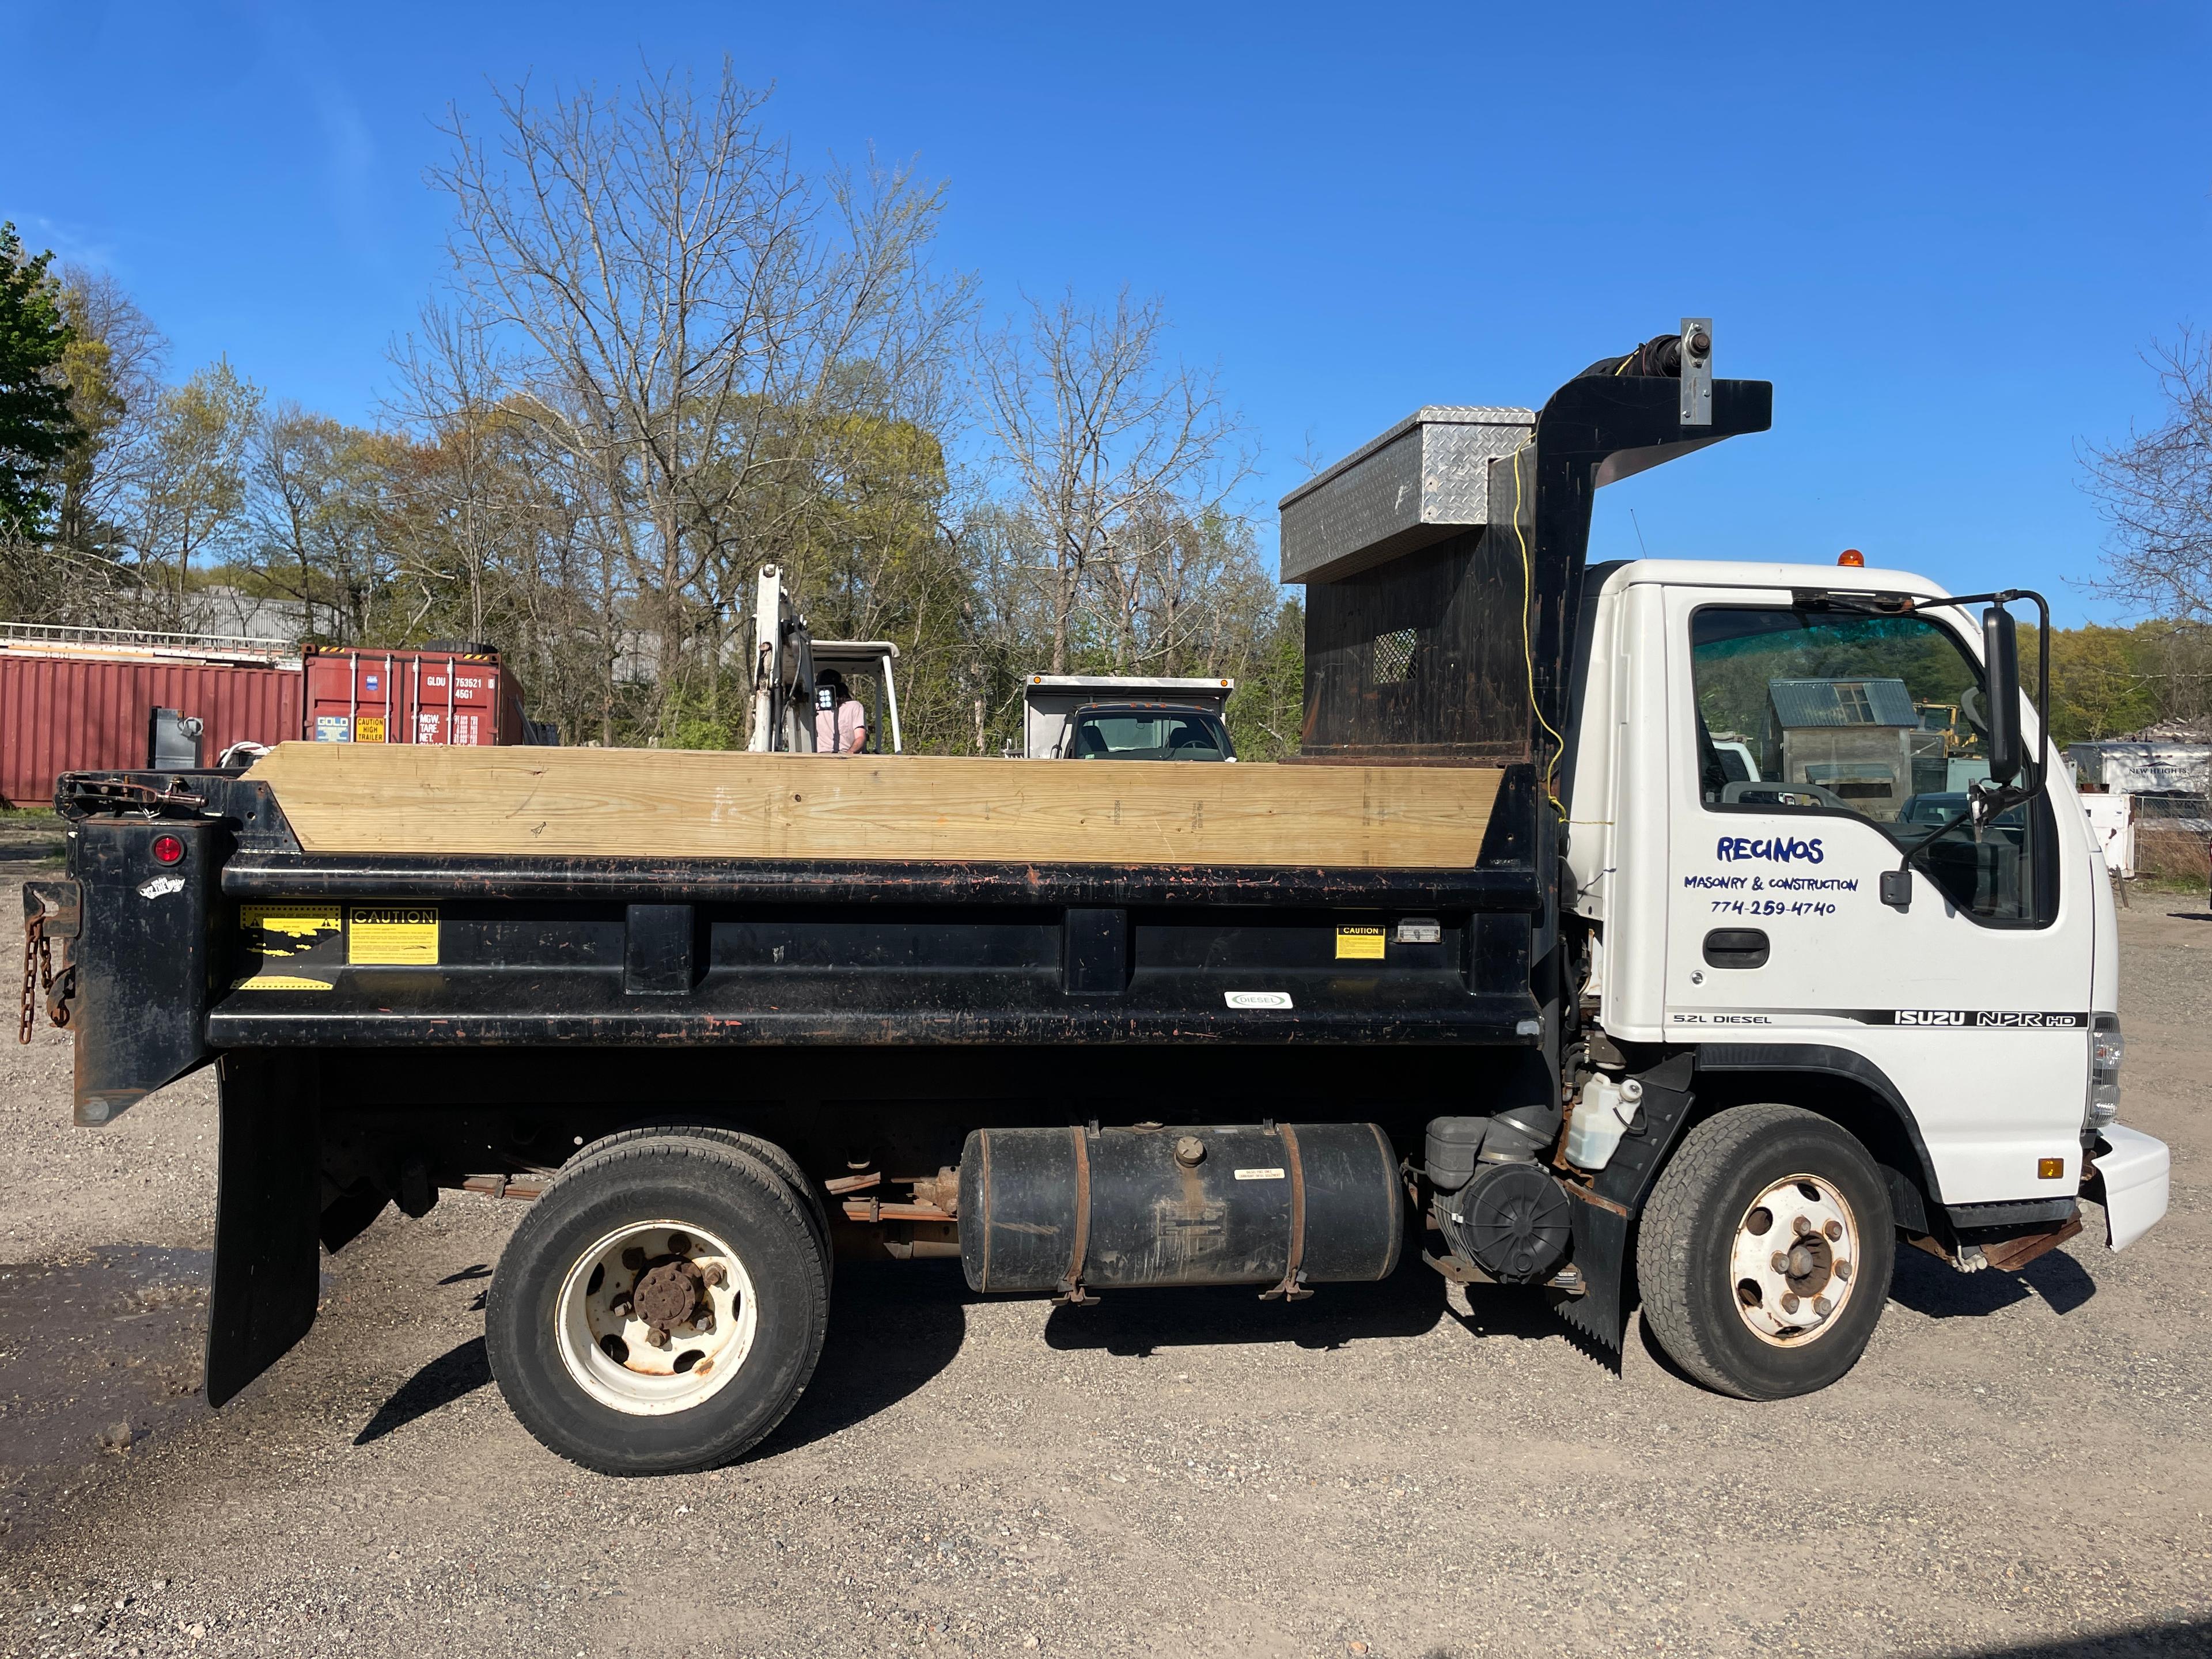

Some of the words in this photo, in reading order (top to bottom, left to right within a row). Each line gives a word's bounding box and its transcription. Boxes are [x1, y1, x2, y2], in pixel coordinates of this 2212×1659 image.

[455, 677, 482, 688] 753521
[454, 689, 473, 699] 45G1
[317, 717, 349, 726] GOLD
[420, 724, 439, 733] TARE.
[419, 733, 433, 742] NET.
[1717, 836, 1824, 864] RECINOS
[1684, 876, 1747, 889] MASONRY
[1752, 876, 1764, 891] &
[1768, 877, 1858, 892] CONSTRUCTION
[1711, 900, 1836, 916] 774-259-4740
[354, 911, 433, 923] CAUTION
[1713, 1016, 1772, 1024] DIESEL
[1895, 1010, 1965, 1025] ISUZU
[1976, 1011, 2043, 1027] NPR
[2046, 1016, 2076, 1026] HD
